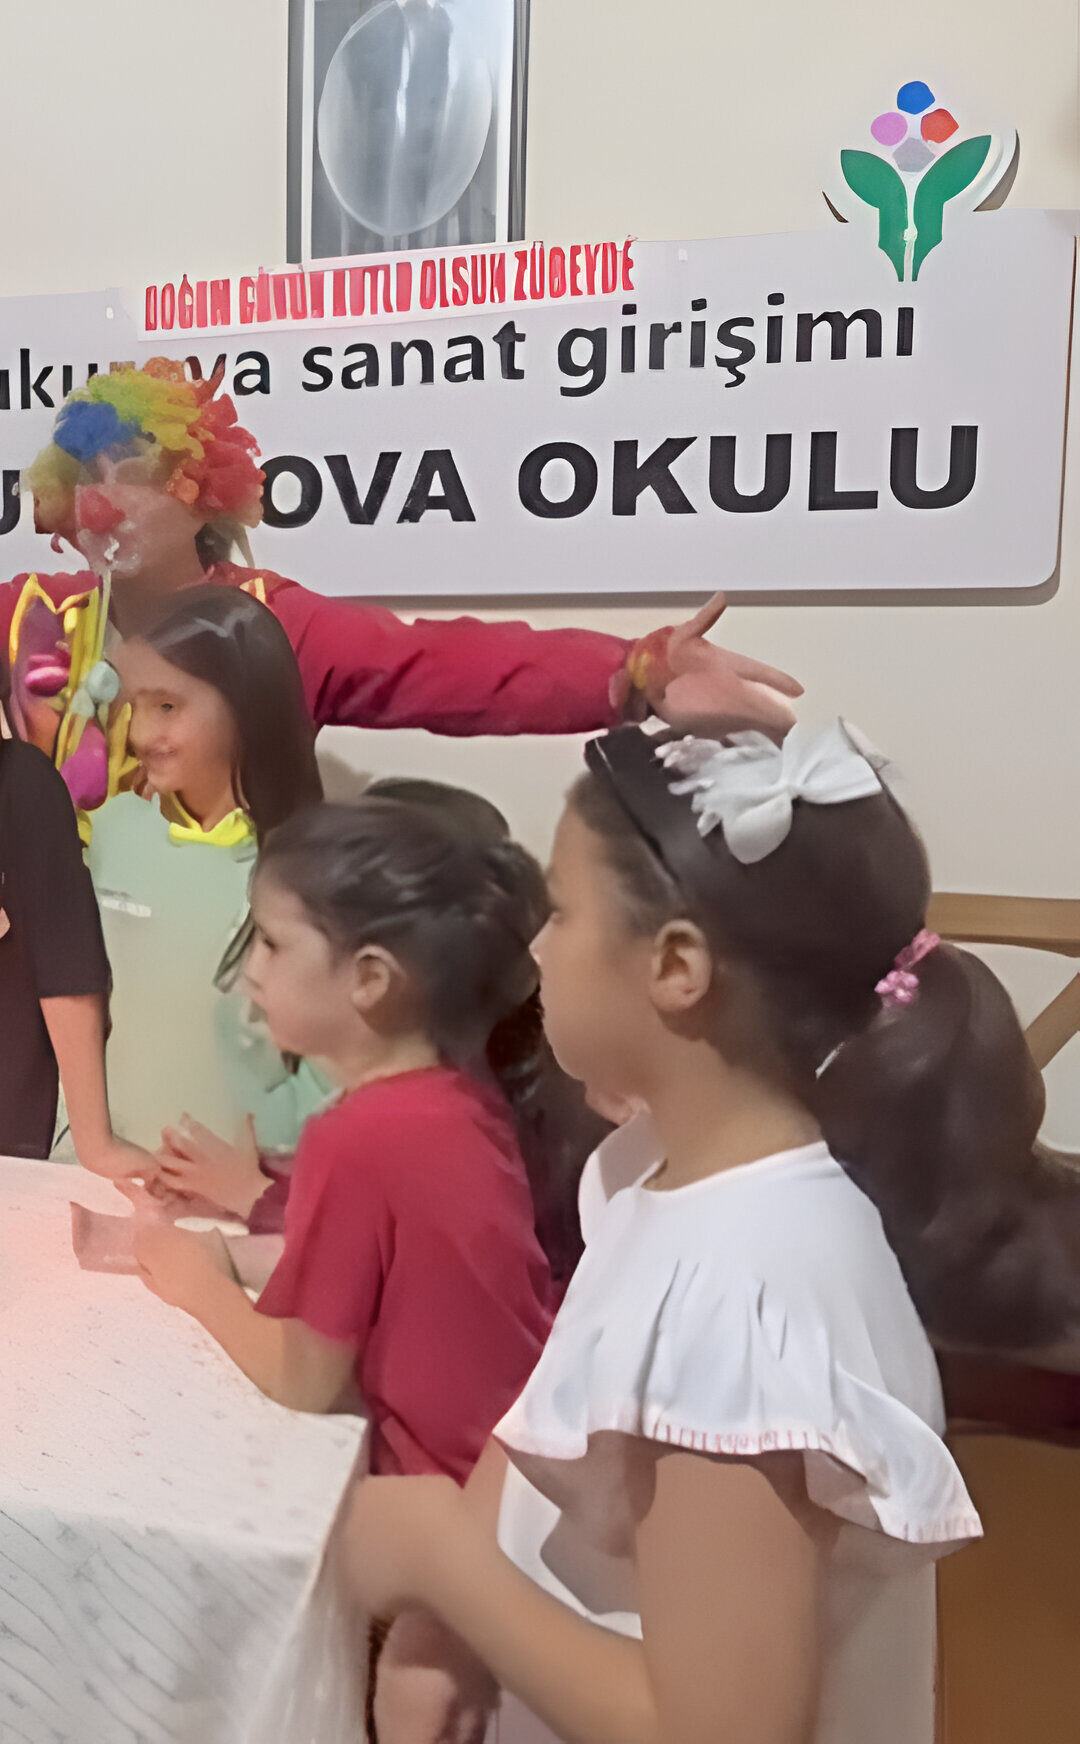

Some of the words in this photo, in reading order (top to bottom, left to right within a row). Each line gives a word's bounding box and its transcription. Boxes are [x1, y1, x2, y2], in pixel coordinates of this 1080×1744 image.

[419, 253, 506, 310] OLSUN
[301, 321, 526, 393] sanat
[518, 425, 979, 519] OKULU
